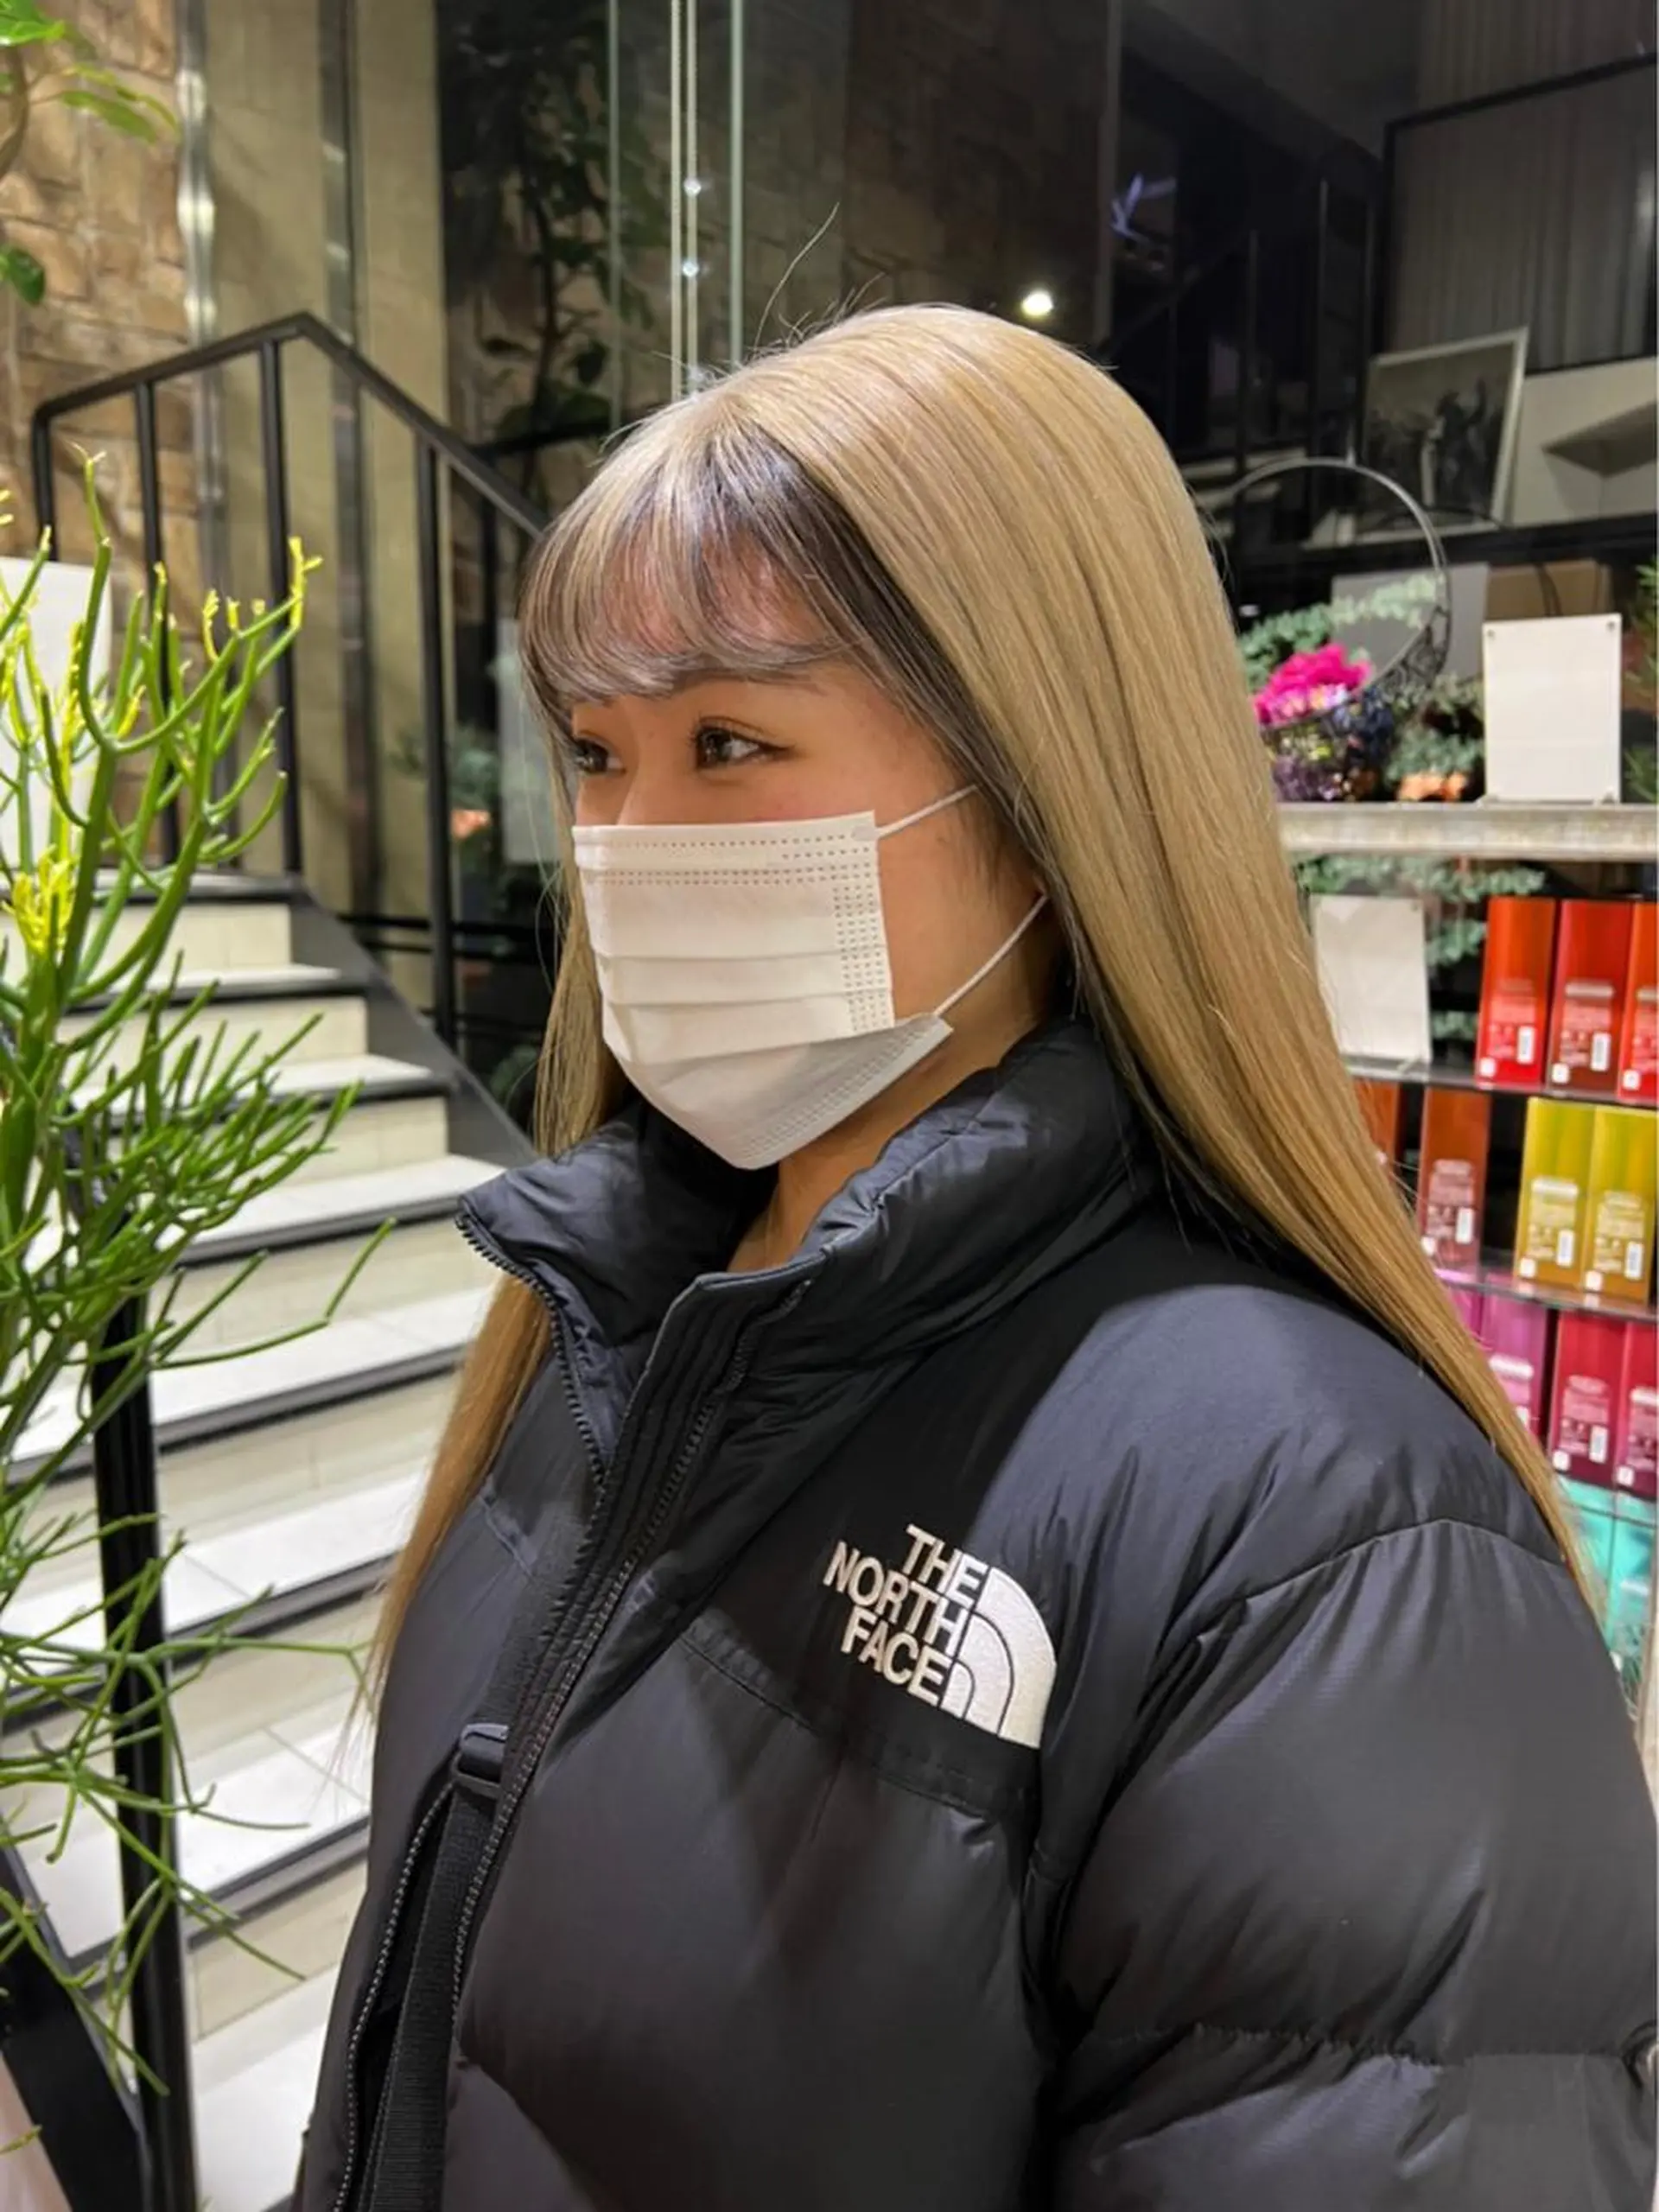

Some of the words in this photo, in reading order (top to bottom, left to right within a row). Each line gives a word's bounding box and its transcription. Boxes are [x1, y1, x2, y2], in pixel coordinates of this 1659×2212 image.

[823, 1540, 969, 1661] NORTH
[900, 1523, 989, 1607] THE
[841, 1605, 953, 1707] FACE
